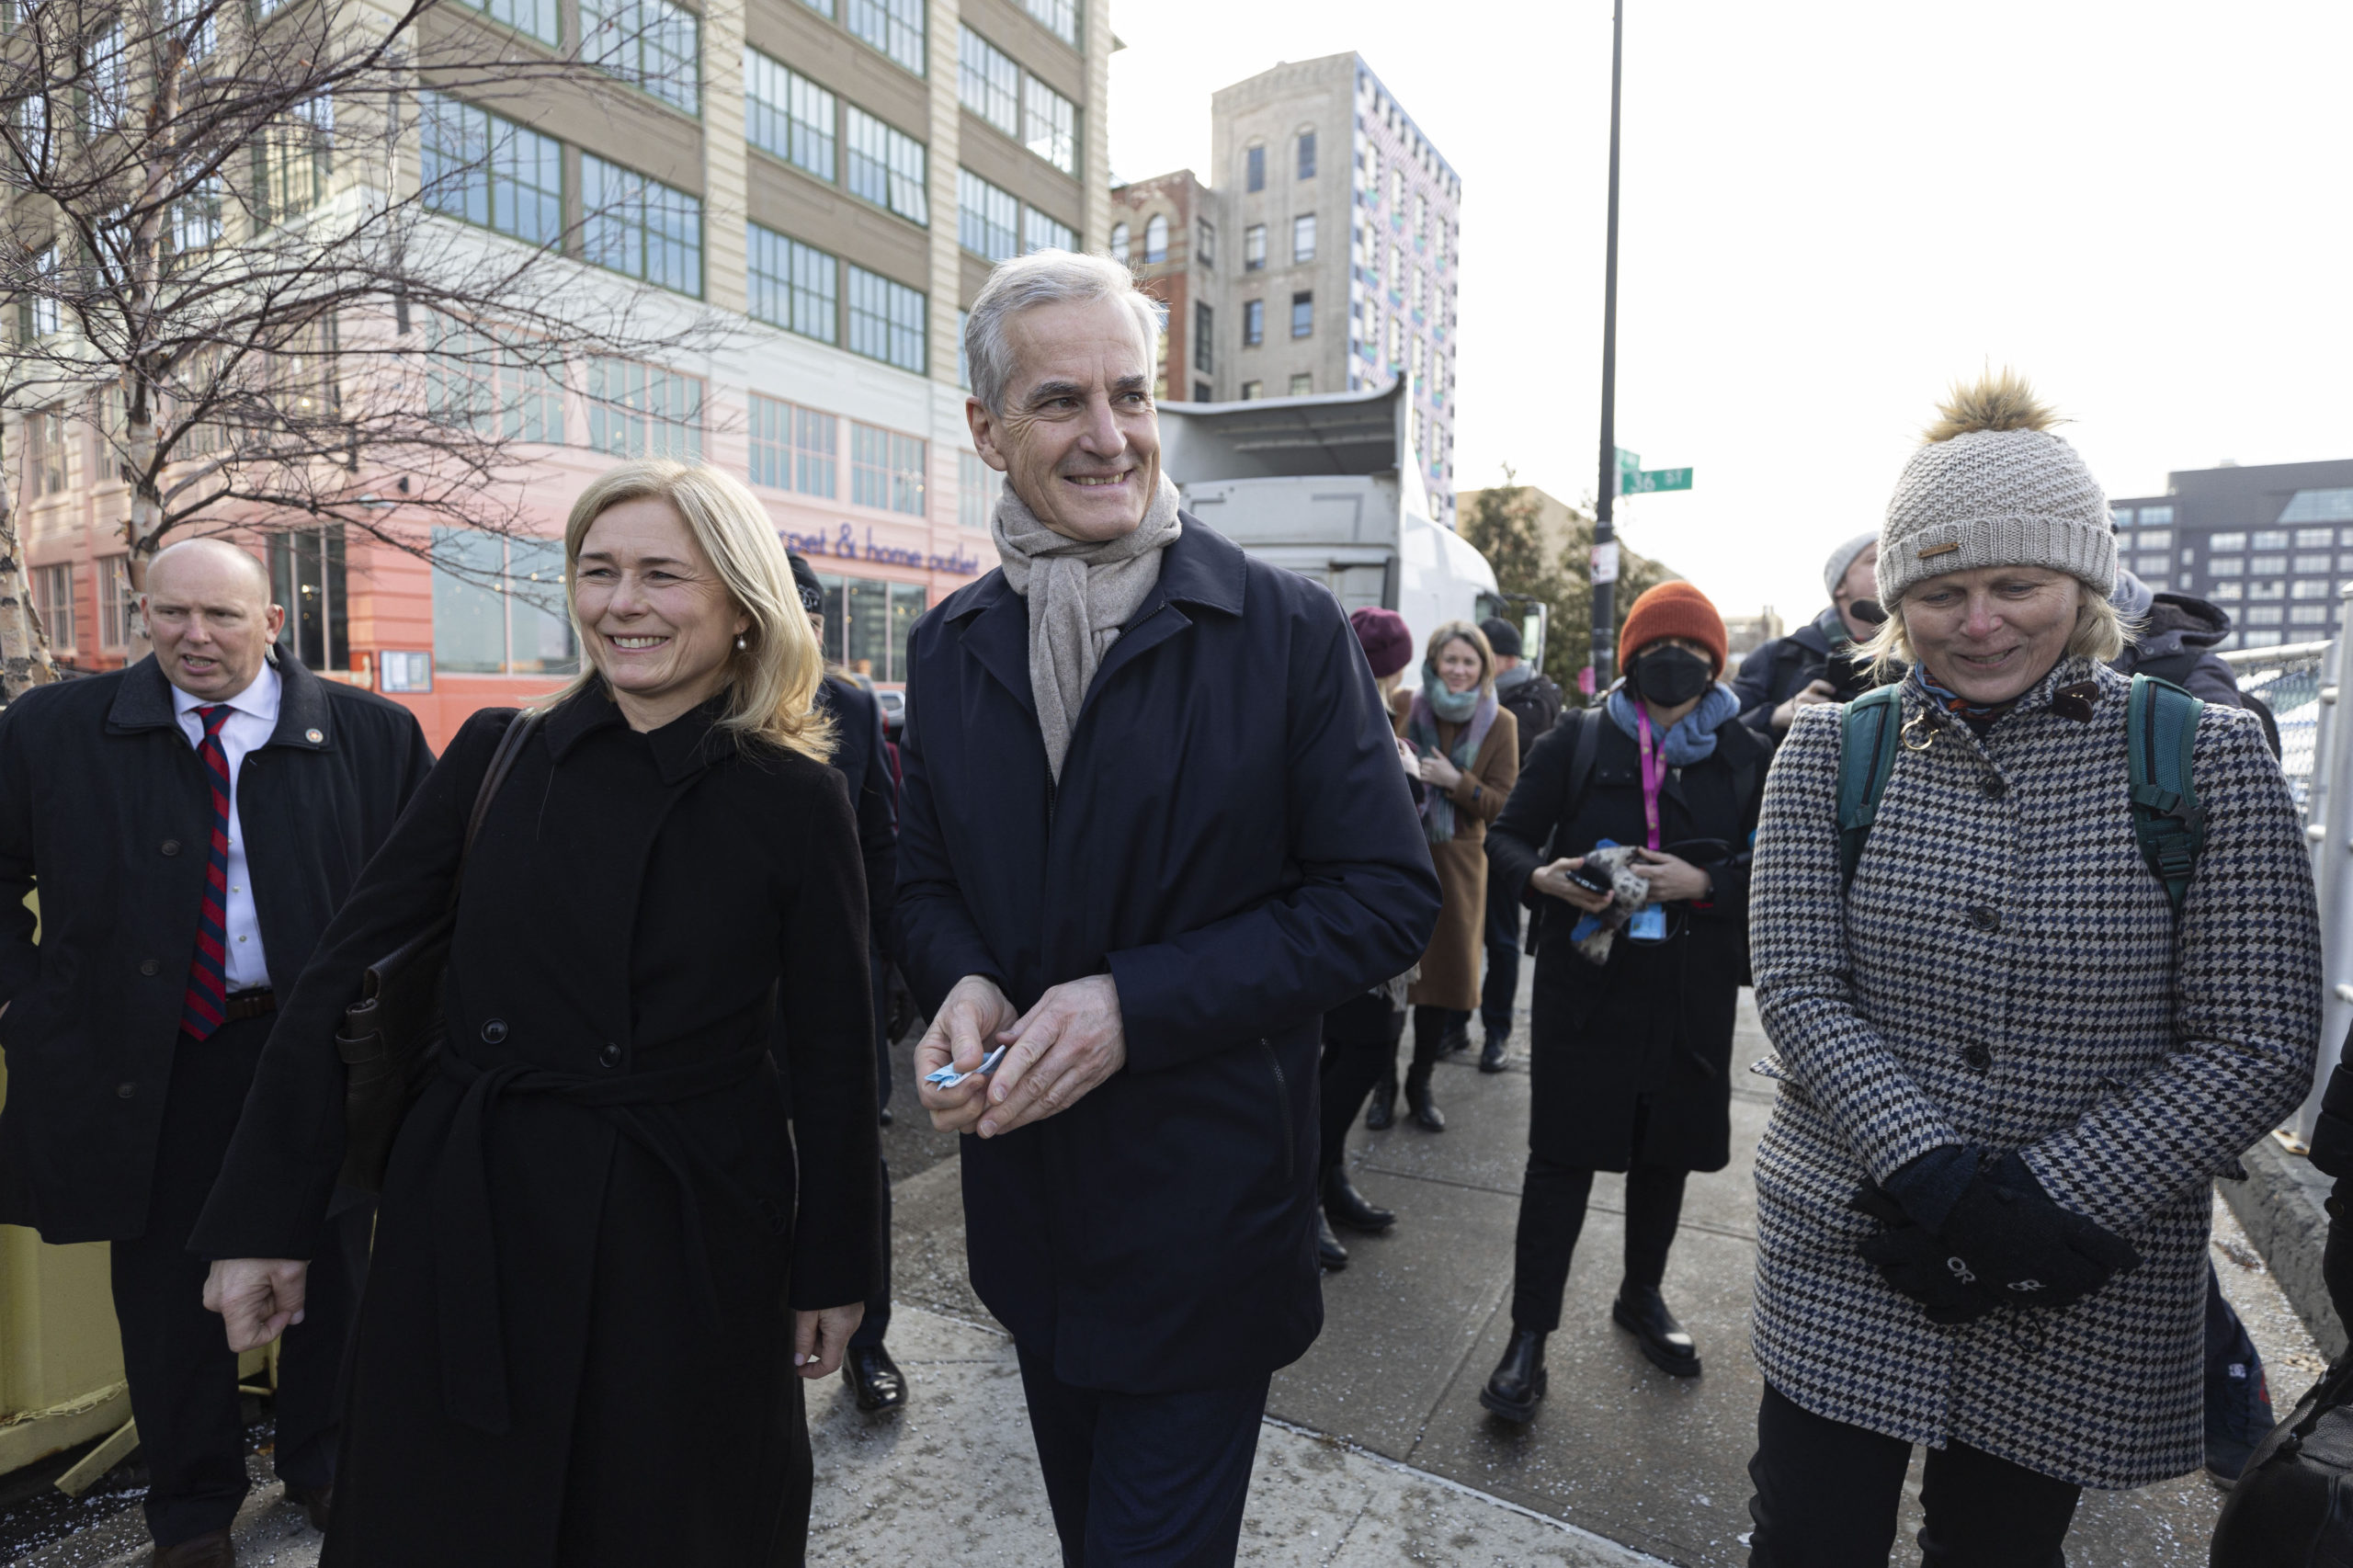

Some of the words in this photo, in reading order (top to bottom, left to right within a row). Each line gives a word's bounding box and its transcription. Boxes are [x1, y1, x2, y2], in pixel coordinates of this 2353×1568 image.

[835, 522, 858, 560] &
[867, 527, 922, 568] home
[928, 542, 979, 576] outlet
[1947, 1256, 1976, 1285] OR
